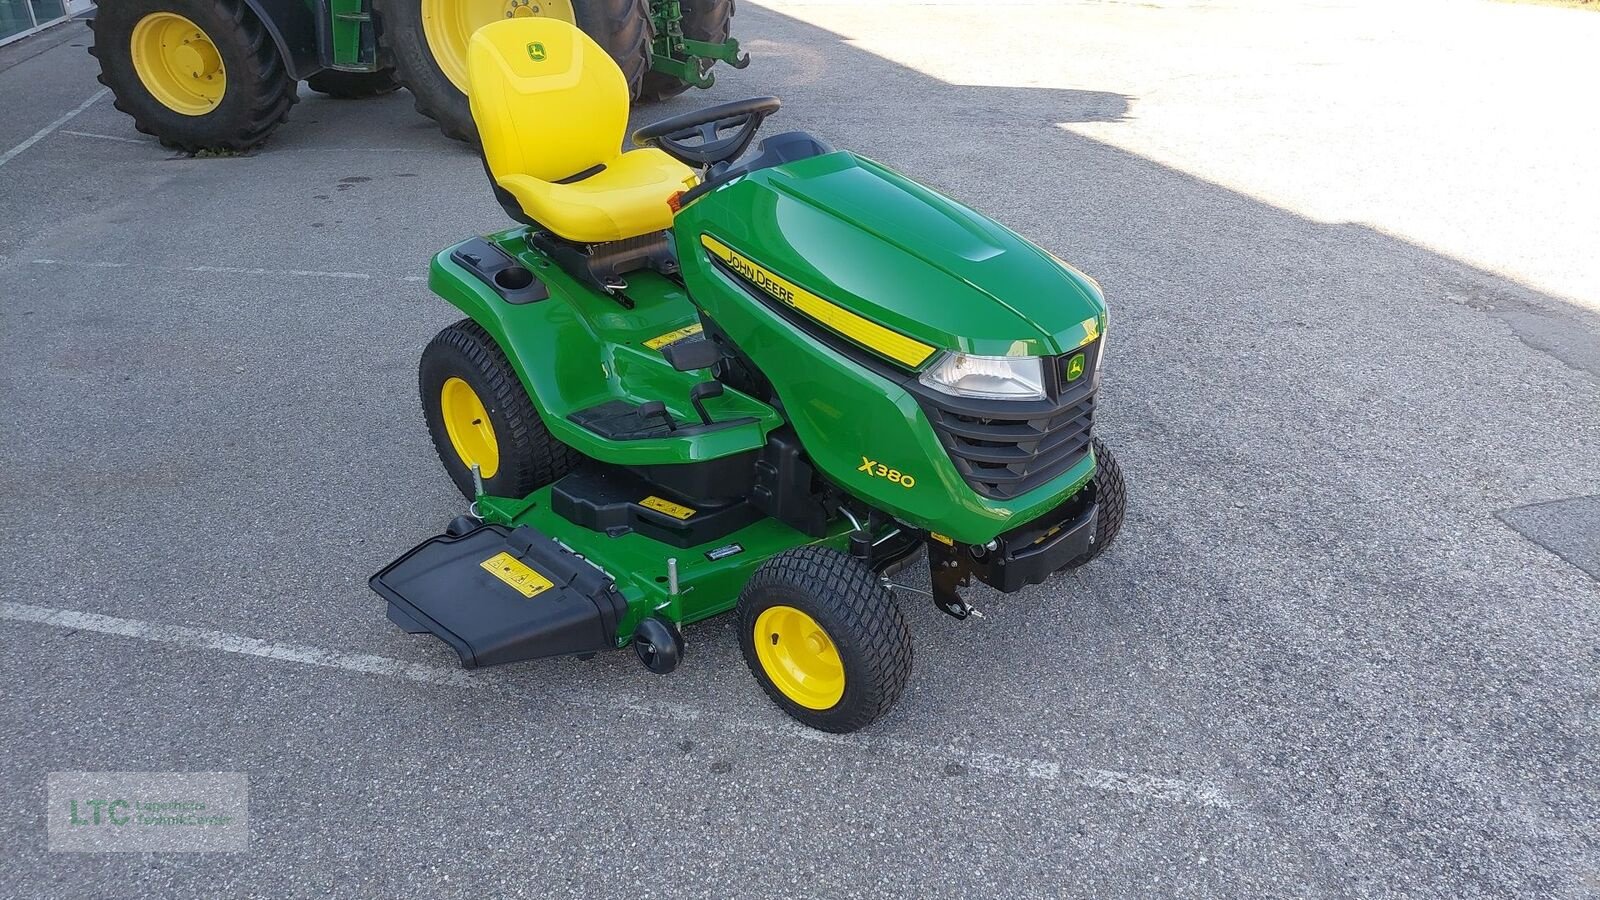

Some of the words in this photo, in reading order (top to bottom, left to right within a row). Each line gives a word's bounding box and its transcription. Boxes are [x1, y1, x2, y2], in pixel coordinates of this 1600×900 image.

[727, 251, 755, 280] JOHN
[756, 270, 795, 305] DEERE
[857, 456, 915, 488] X380
